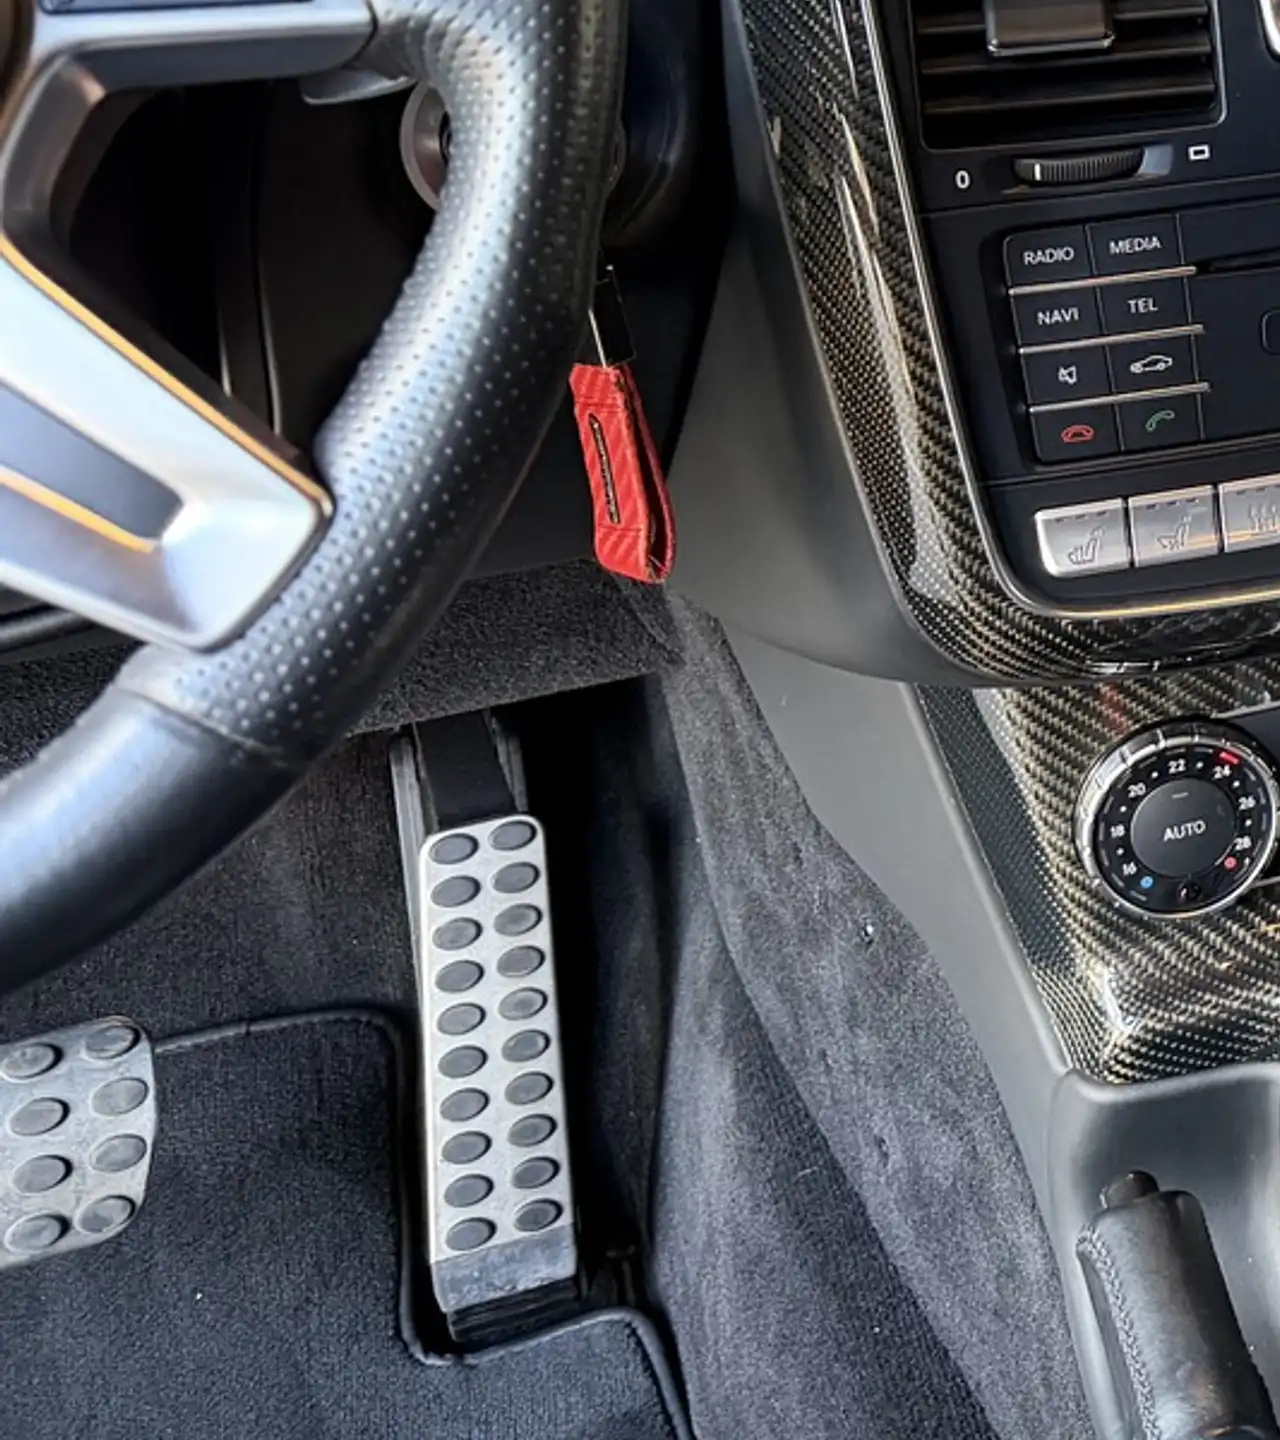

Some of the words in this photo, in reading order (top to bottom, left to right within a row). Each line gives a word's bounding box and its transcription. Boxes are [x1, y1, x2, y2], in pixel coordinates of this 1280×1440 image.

[1023, 245, 1076, 267] RADIO
[1109, 235, 1162, 256] MEDIA
[1127, 296, 1160, 315] TEL
[1036, 306, 1080, 327] NAVI
[1168, 759, 1187, 774] 22
[1212, 763, 1232, 780] 24
[1163, 819, 1207, 843] AUTO
